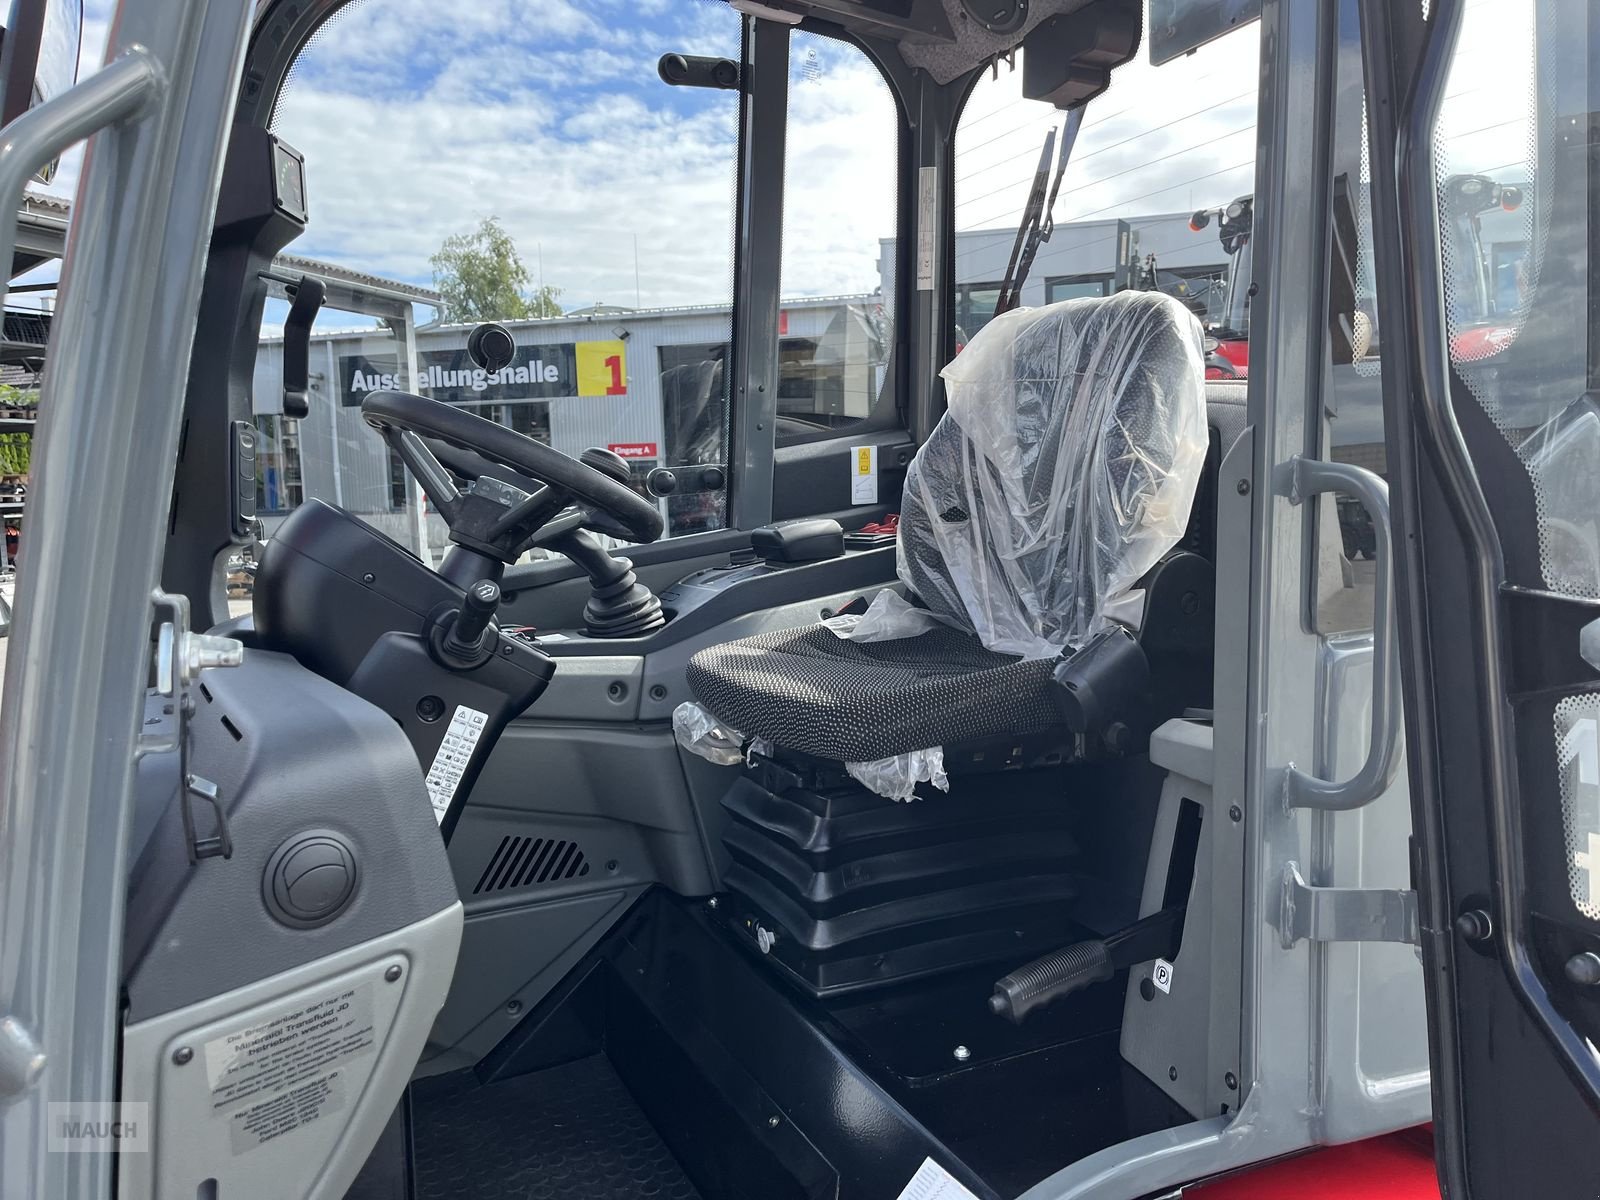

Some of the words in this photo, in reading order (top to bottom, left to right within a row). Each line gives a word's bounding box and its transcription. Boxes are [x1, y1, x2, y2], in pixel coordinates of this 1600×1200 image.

[351, 360, 559, 392] Aussellungshalle
[605, 355, 627, 395] 1
[643, 446, 650, 455] A
[285, 1008, 334, 1032] Transfluid
[336, 1002, 350, 1013] JD
[247, 1032, 299, 1057] betrieben
[301, 1016, 338, 1035] werden
